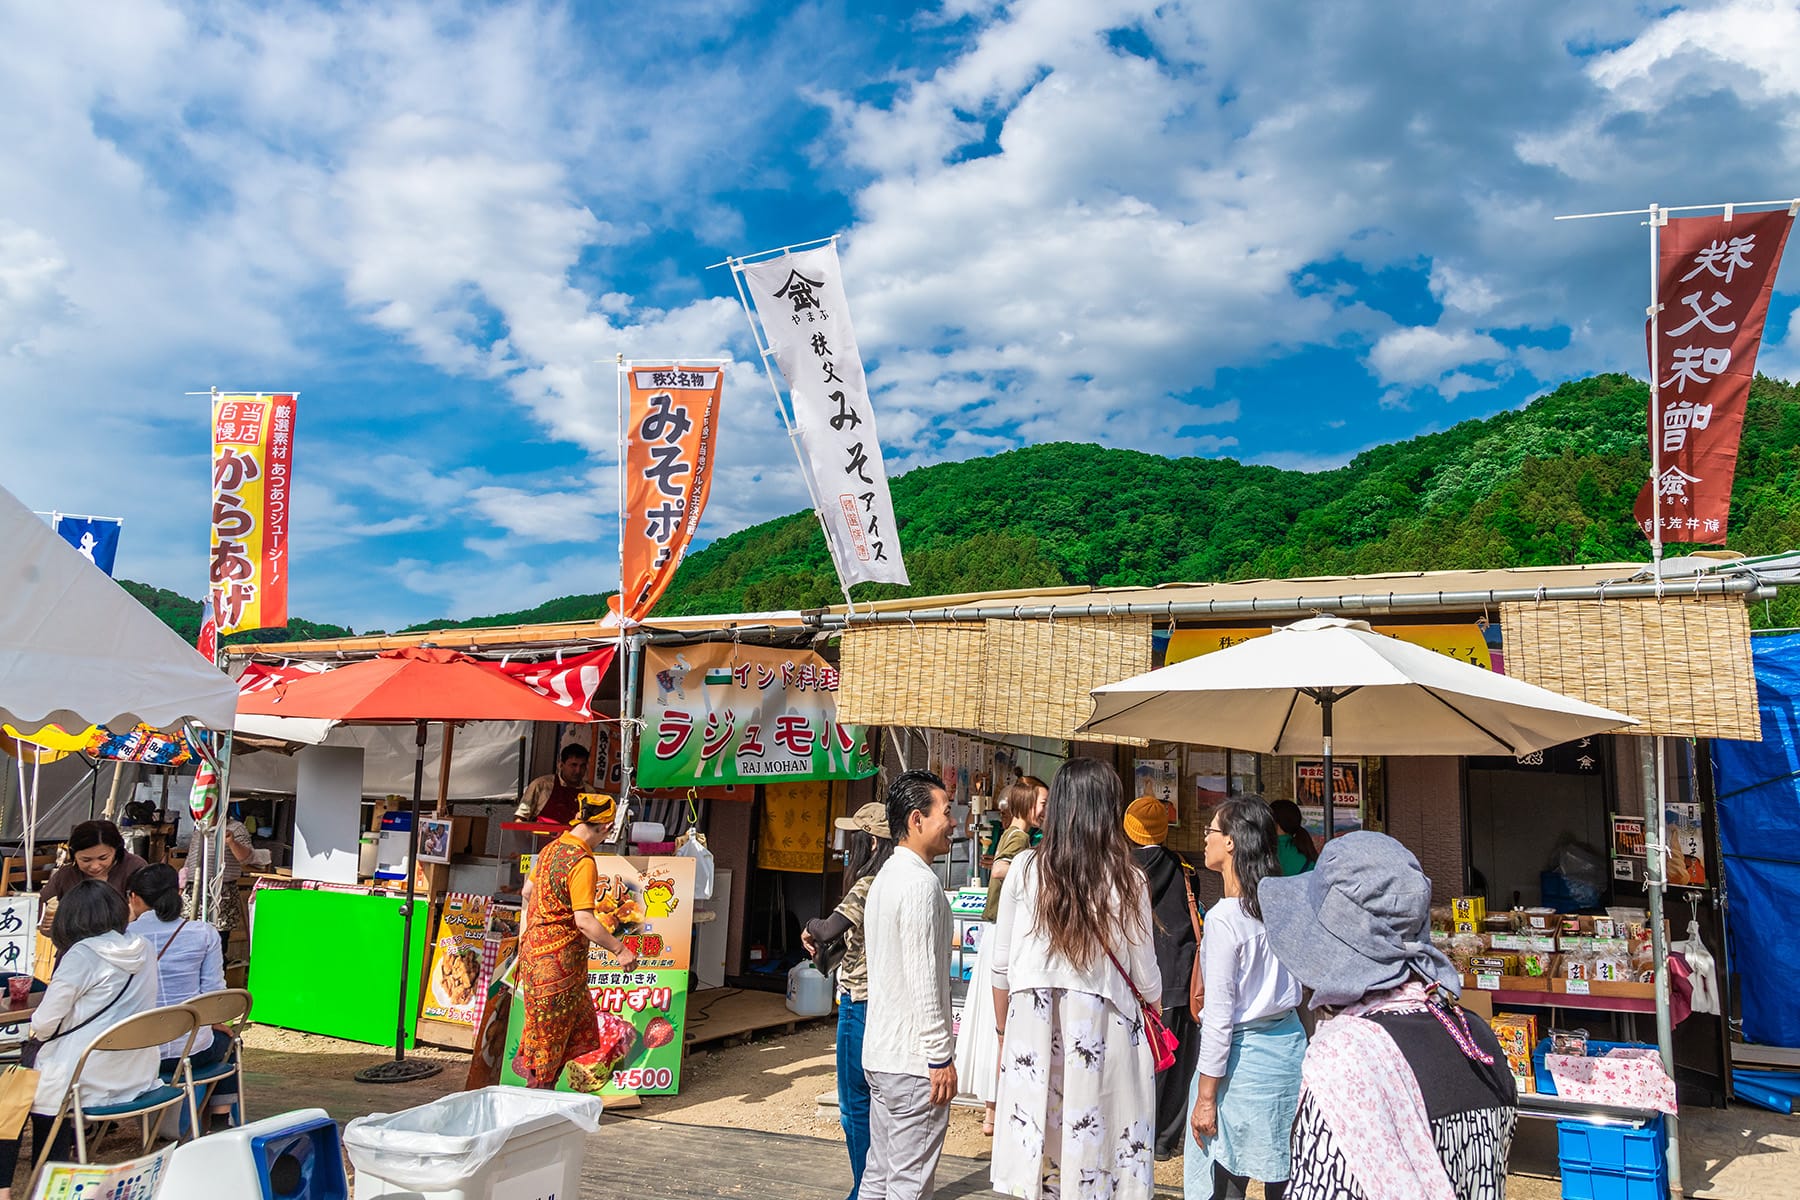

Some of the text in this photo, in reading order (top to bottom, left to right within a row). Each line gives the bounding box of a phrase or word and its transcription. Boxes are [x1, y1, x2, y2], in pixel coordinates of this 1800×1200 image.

[652, 371, 704, 388] 秩父名物
[271, 404, 291, 459] 厳選素材
[638, 394, 692, 604] みそポ
[209, 447, 260, 628] からあげ
[1219, 636, 1250, 650] 秩
[734, 662, 840, 691] インド料理
[655, 708, 869, 760] ラジュモハ
[742, 759, 808, 774] RAJ MOHAN
[1300, 767, 1341, 778] 黄金だご
[587, 973, 657, 985] 新感覚かき氷
[613, 1067, 673, 1090] ¥500
